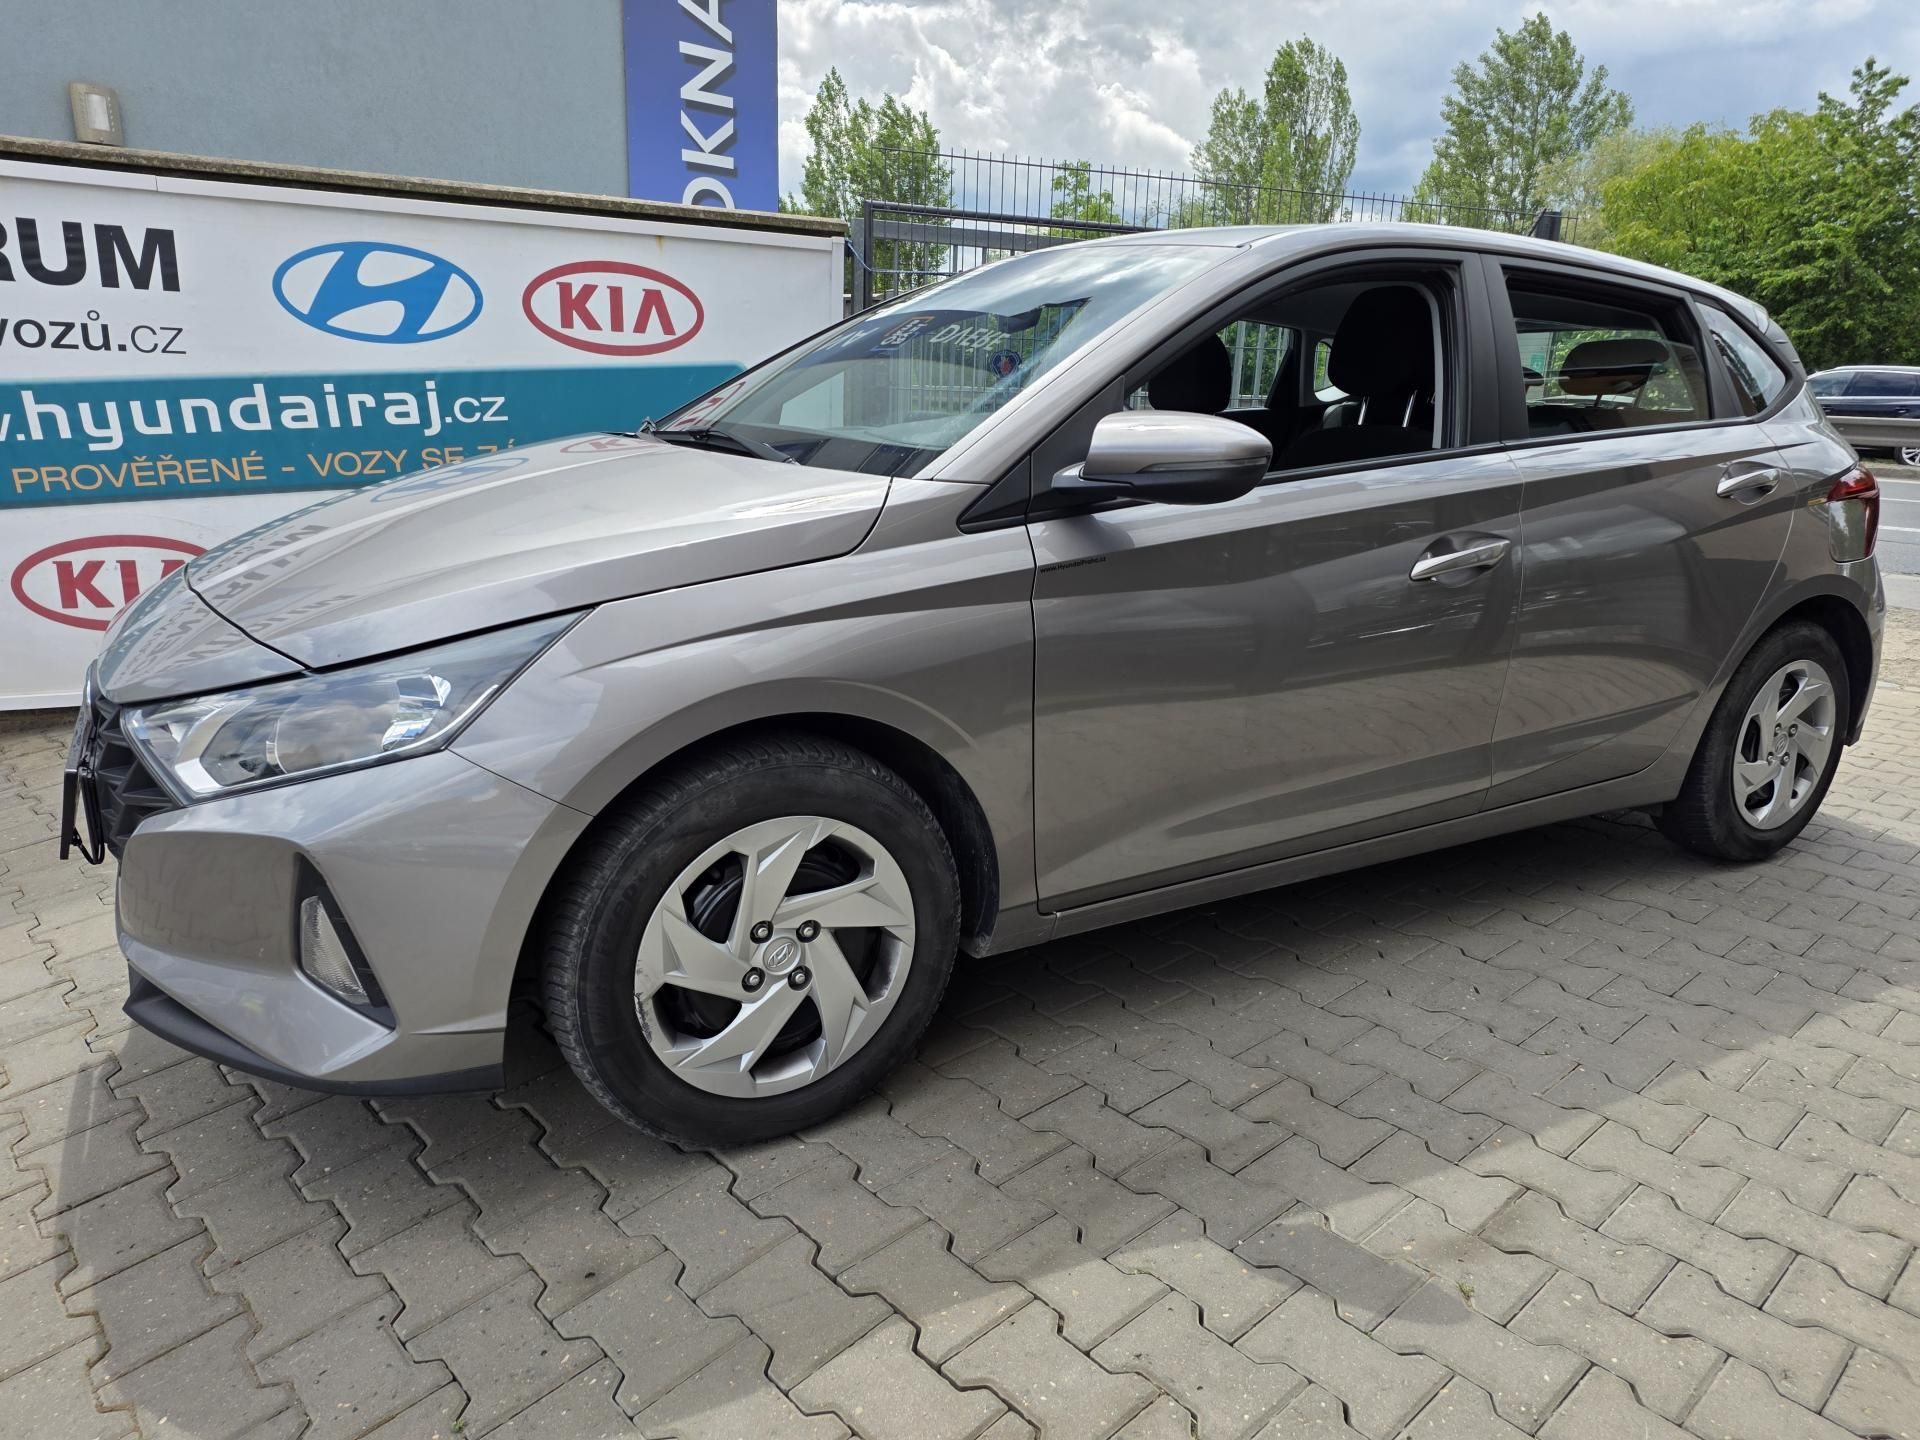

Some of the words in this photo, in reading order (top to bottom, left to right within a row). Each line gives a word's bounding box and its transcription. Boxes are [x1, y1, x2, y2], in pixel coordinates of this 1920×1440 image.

[556, 281, 676, 336] KIA
[0, 310, 187, 354] ozů.cz
[12, 449, 267, 493] PROVĚŘENÉ
[307, 448, 408, 477] VOZY
